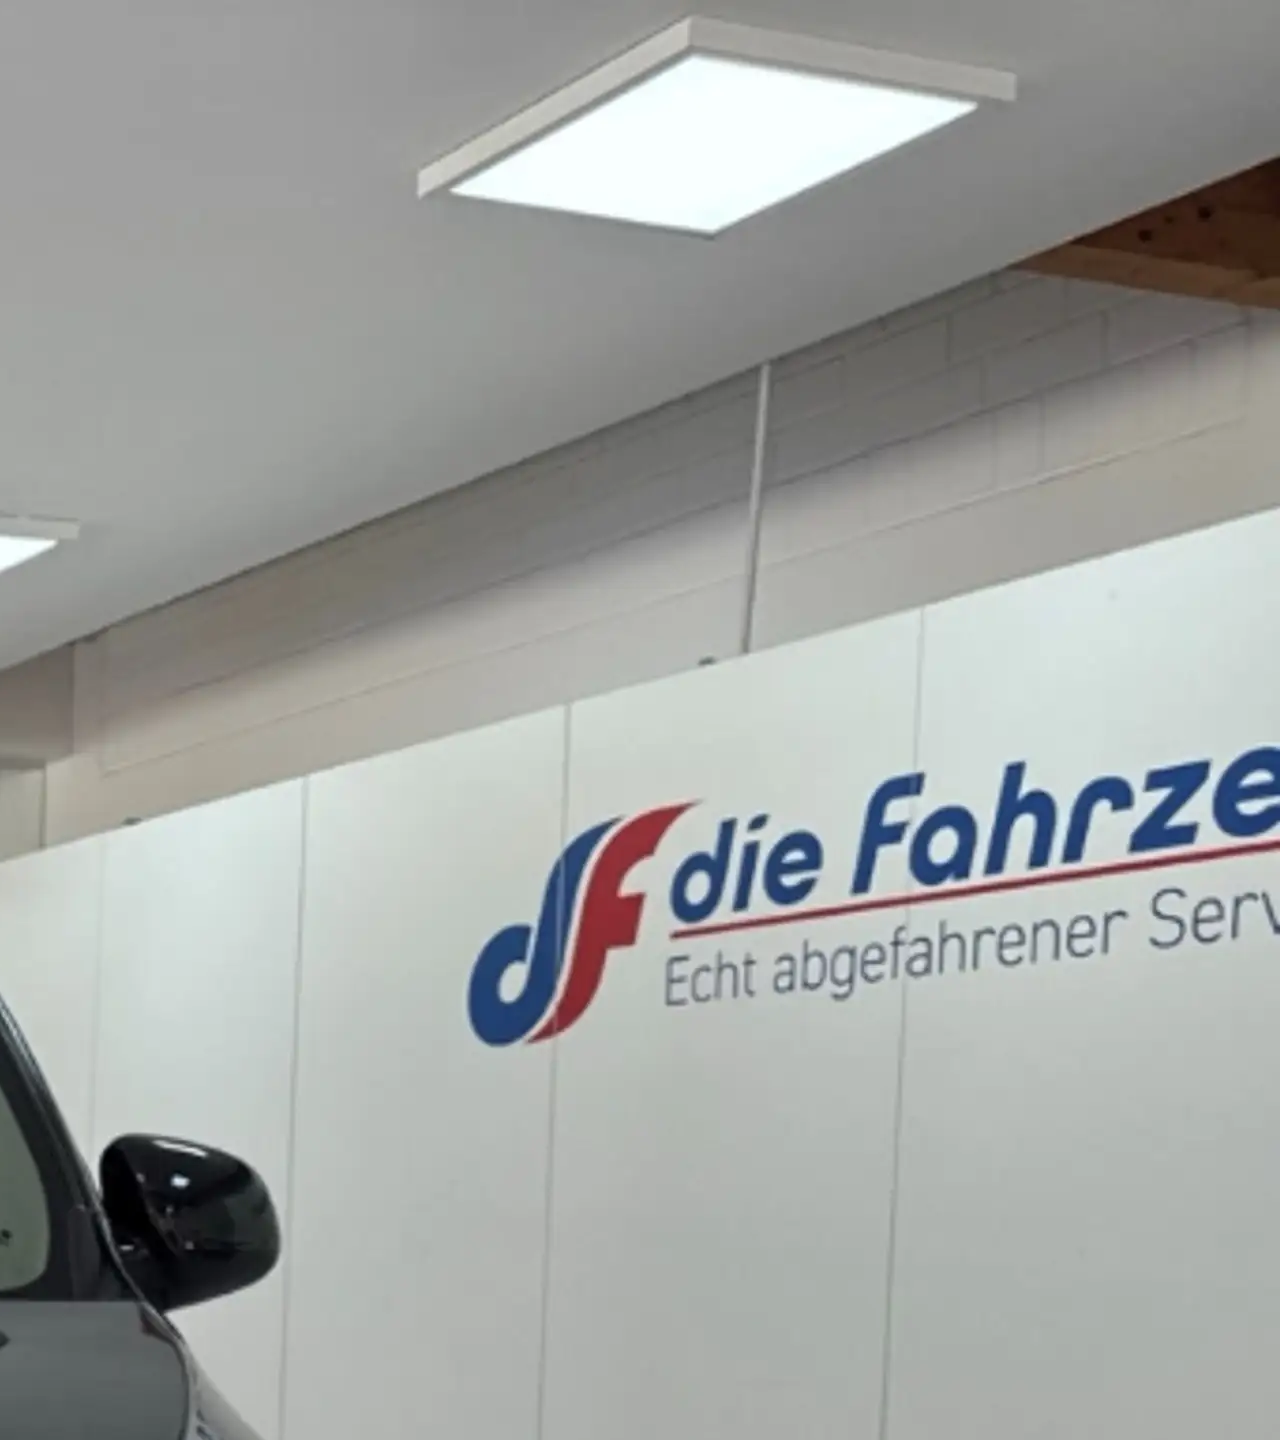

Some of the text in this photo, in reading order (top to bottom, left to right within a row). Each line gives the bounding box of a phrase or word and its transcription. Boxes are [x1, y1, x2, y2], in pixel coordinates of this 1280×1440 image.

[669, 746, 1280, 923] die Fahrze
[664, 948, 757, 1008] Echt
[772, 908, 1128, 1001] abgefahrener
